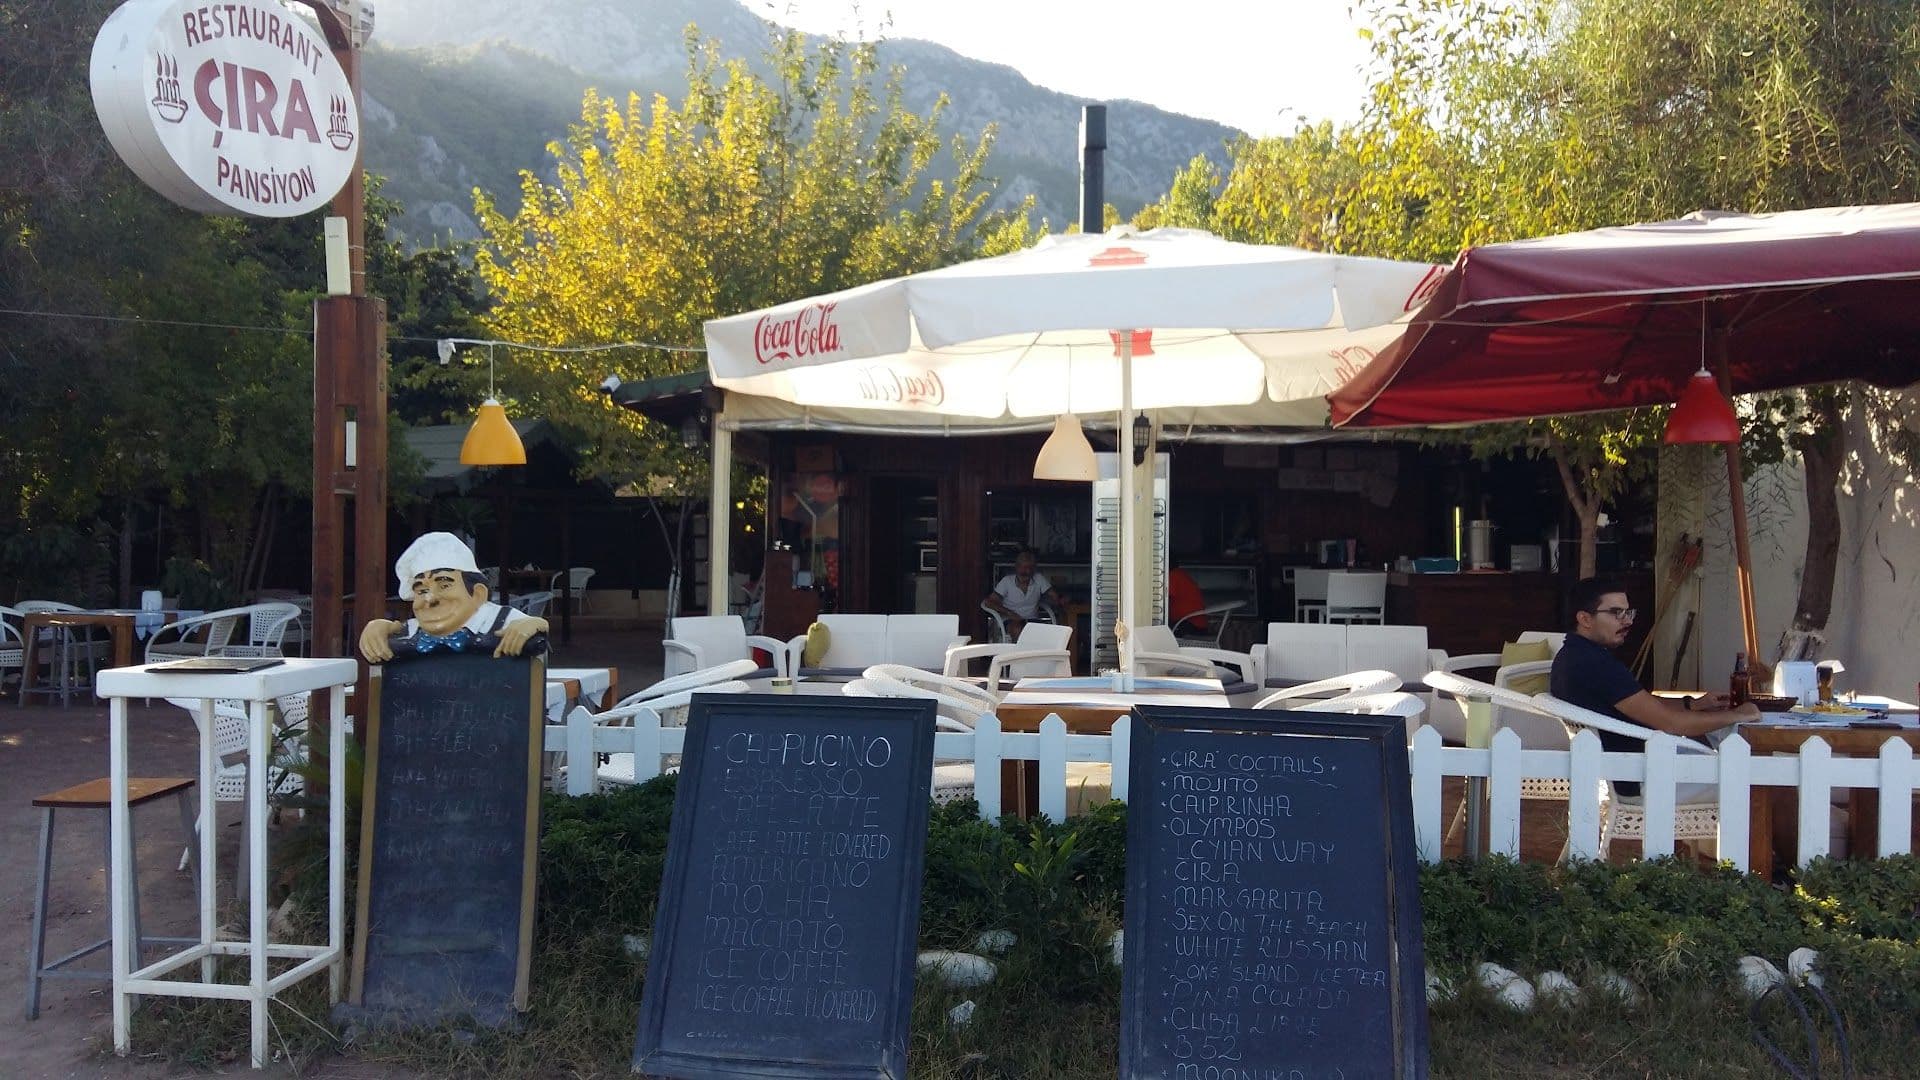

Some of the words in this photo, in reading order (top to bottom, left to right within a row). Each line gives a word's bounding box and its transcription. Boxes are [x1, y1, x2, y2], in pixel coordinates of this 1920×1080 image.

[183, 5, 323, 76] RESTAURANT
[194, 57, 322, 149] ÇIRA
[217, 155, 316, 204] PANSİYON
[754, 300, 841, 365] Coca-Cola
[726, 732, 892, 768] CAPPUCINO
[1228, 754, 1324, 774] COCTAILS
[1173, 774, 1258, 793] MOJITO
[1170, 817, 1276, 839] OLYMPOS
[1273, 839, 1335, 864] WAY
[1218, 911, 1245, 932] ON
[1254, 914, 1293, 933] THE
[1259, 936, 1368, 962] RUSSIAN
[759, 949, 848, 984] COFFEE
[1171, 1007, 1240, 1033] CUBA
